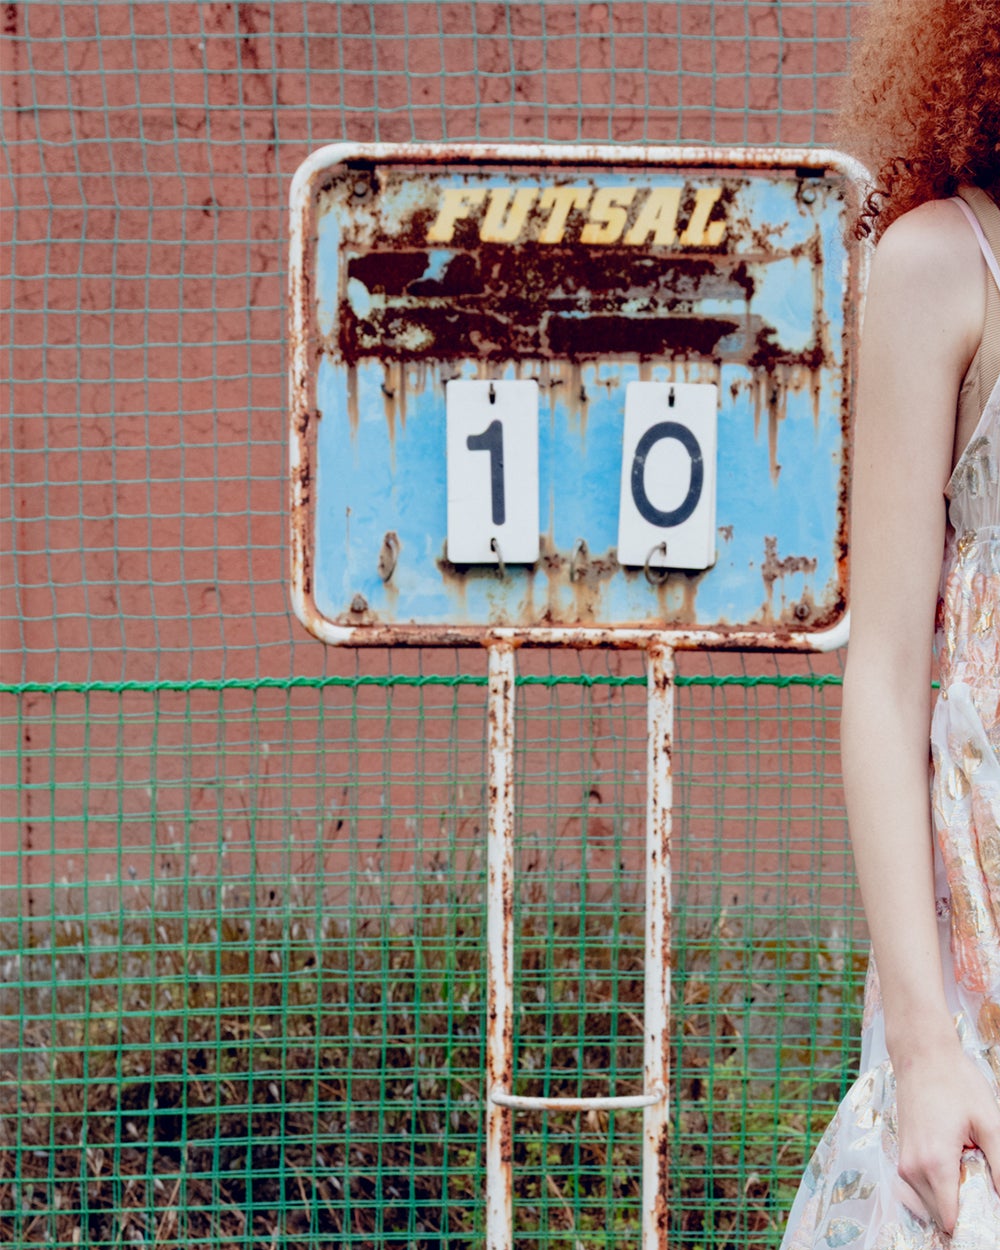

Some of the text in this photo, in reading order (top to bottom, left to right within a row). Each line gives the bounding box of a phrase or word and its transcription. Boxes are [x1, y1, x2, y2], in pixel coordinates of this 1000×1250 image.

[427, 187, 727, 245] FUTSAL
[467, 420, 703, 528] 1 0
